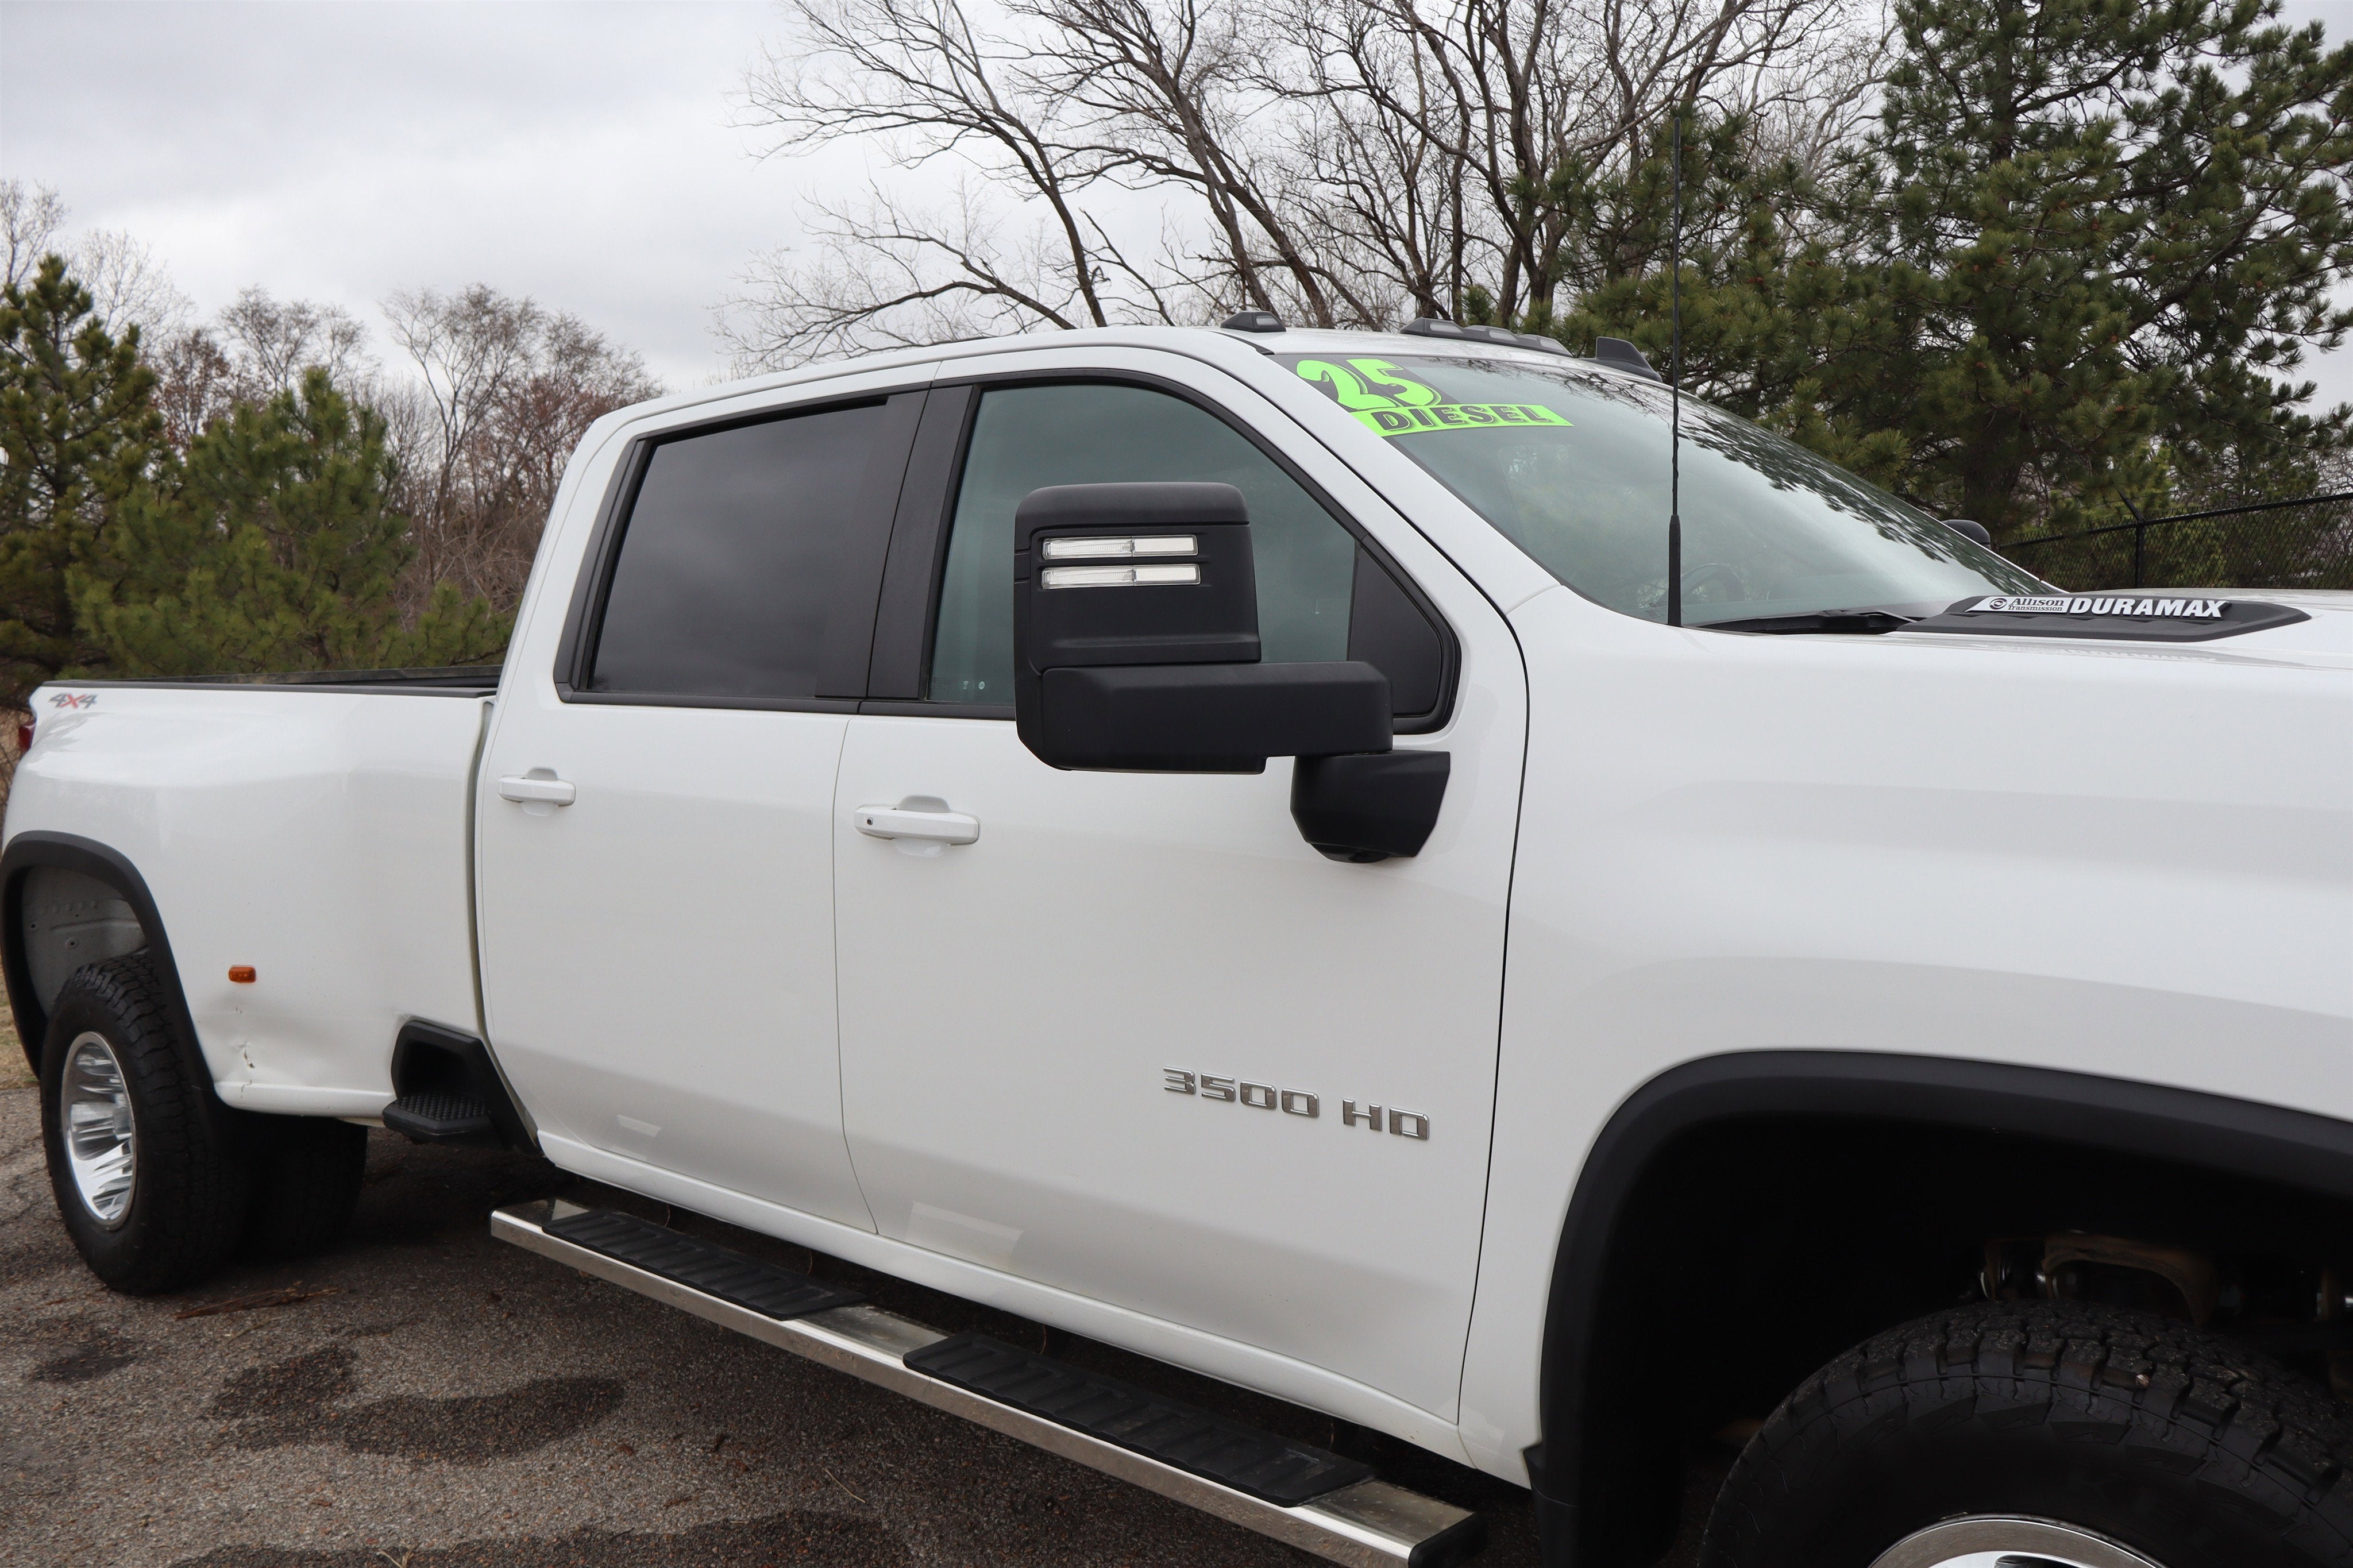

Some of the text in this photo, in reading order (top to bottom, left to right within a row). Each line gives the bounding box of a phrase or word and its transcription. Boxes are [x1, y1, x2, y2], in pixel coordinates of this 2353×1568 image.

[1296, 358, 1442, 411] 25
[1370, 405, 1550, 431] DIESEL
[2010, 598, 2065, 607] Allison
[2069, 597, 2229, 617] DURAMAX
[1163, 1066, 1430, 1141] 3500 HD
